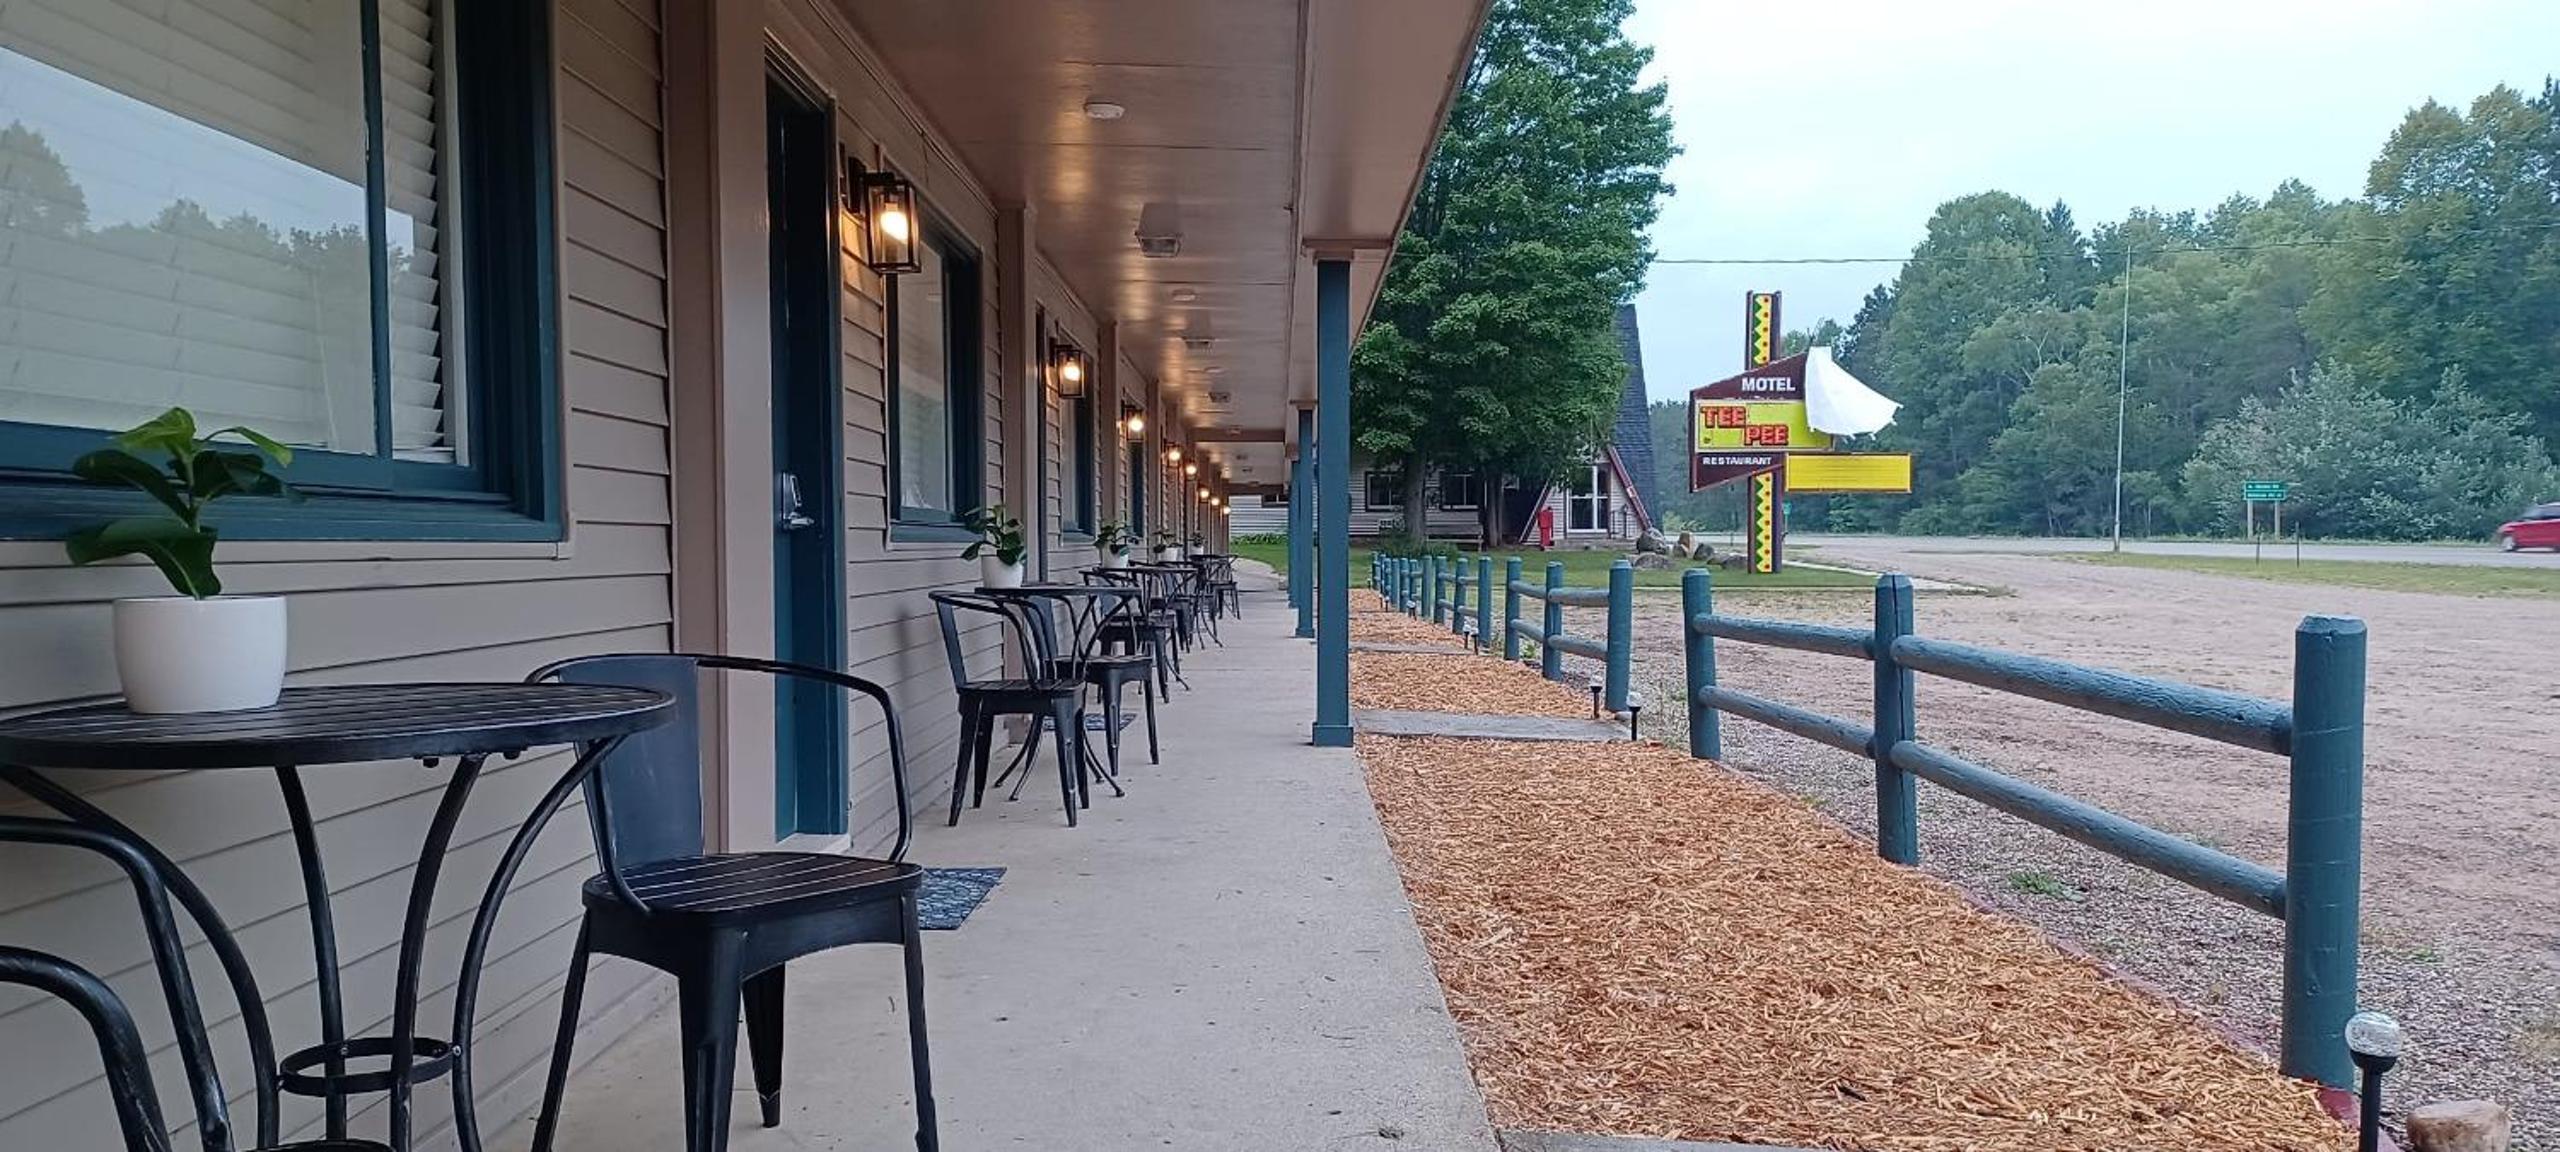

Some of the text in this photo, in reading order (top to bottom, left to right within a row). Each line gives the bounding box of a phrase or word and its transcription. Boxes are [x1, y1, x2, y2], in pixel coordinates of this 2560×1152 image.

[1742, 377, 1796, 391] MOTEL
[1700, 405, 1746, 429] TEE
[1744, 424, 1789, 446] PEE
[1702, 456, 1772, 465] RESTAURANT
